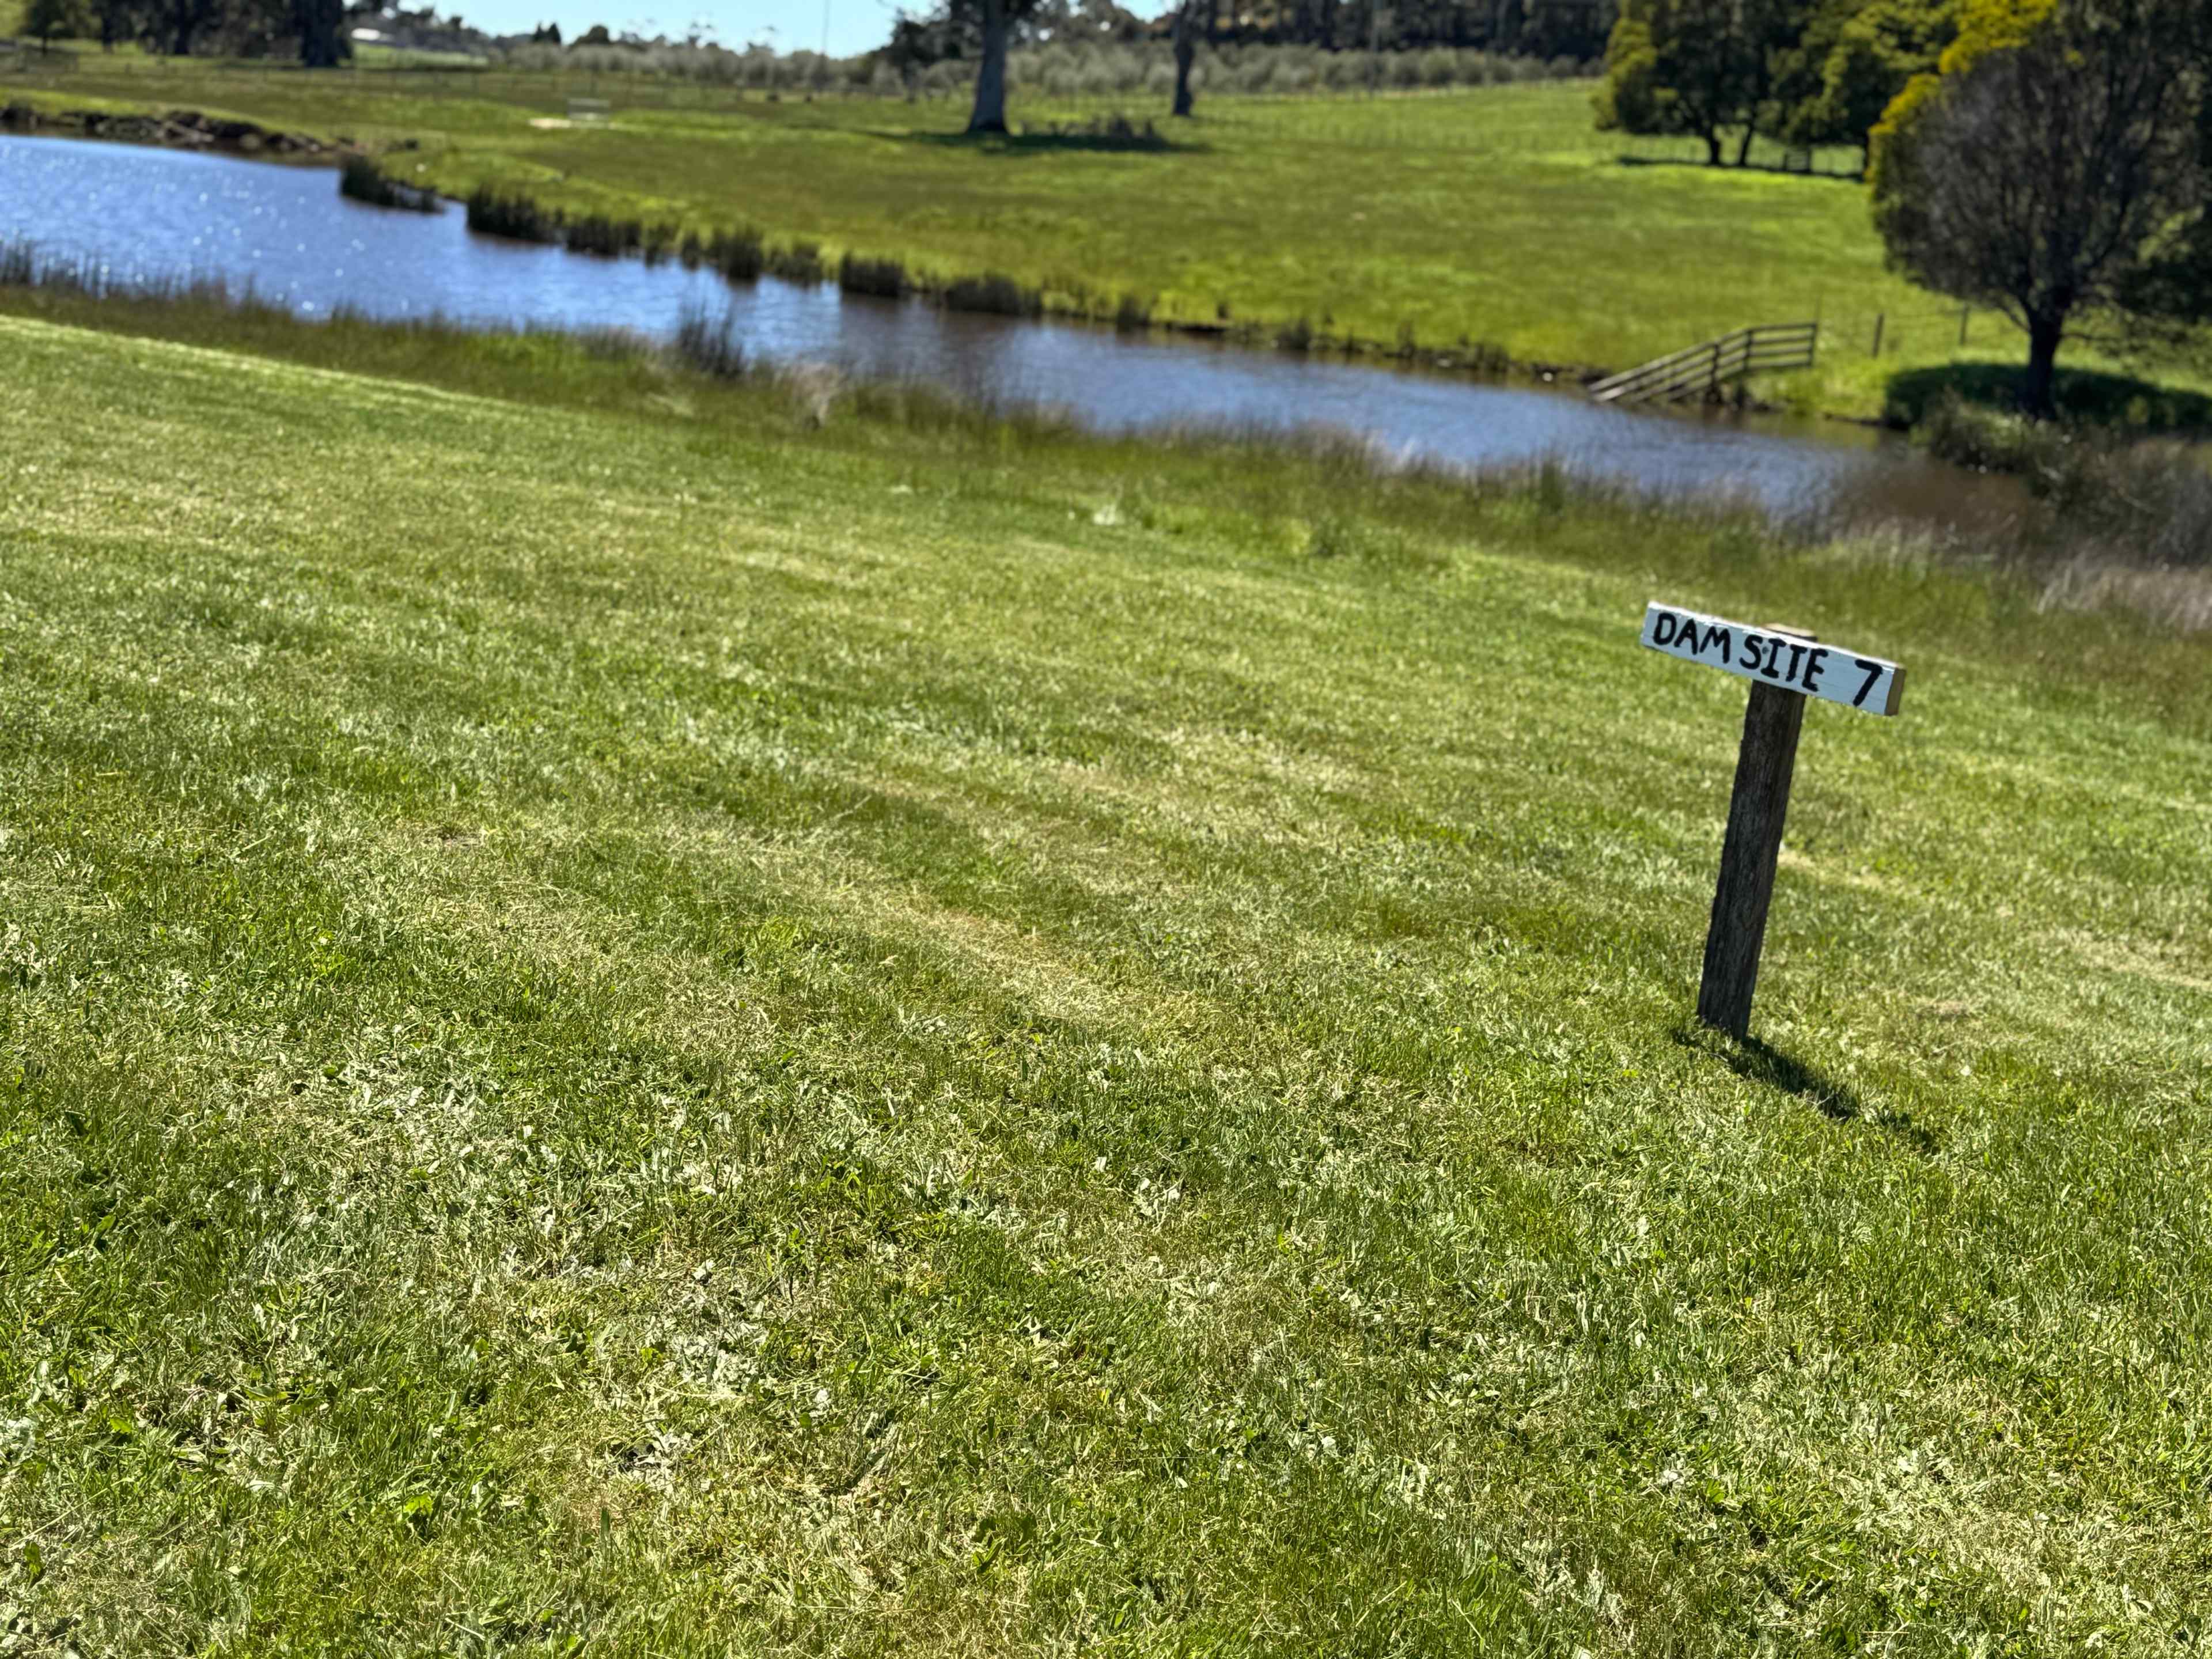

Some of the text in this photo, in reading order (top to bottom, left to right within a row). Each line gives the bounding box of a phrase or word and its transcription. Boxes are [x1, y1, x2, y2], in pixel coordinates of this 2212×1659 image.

[1652, 612, 1883, 707] DAM SITE 7
